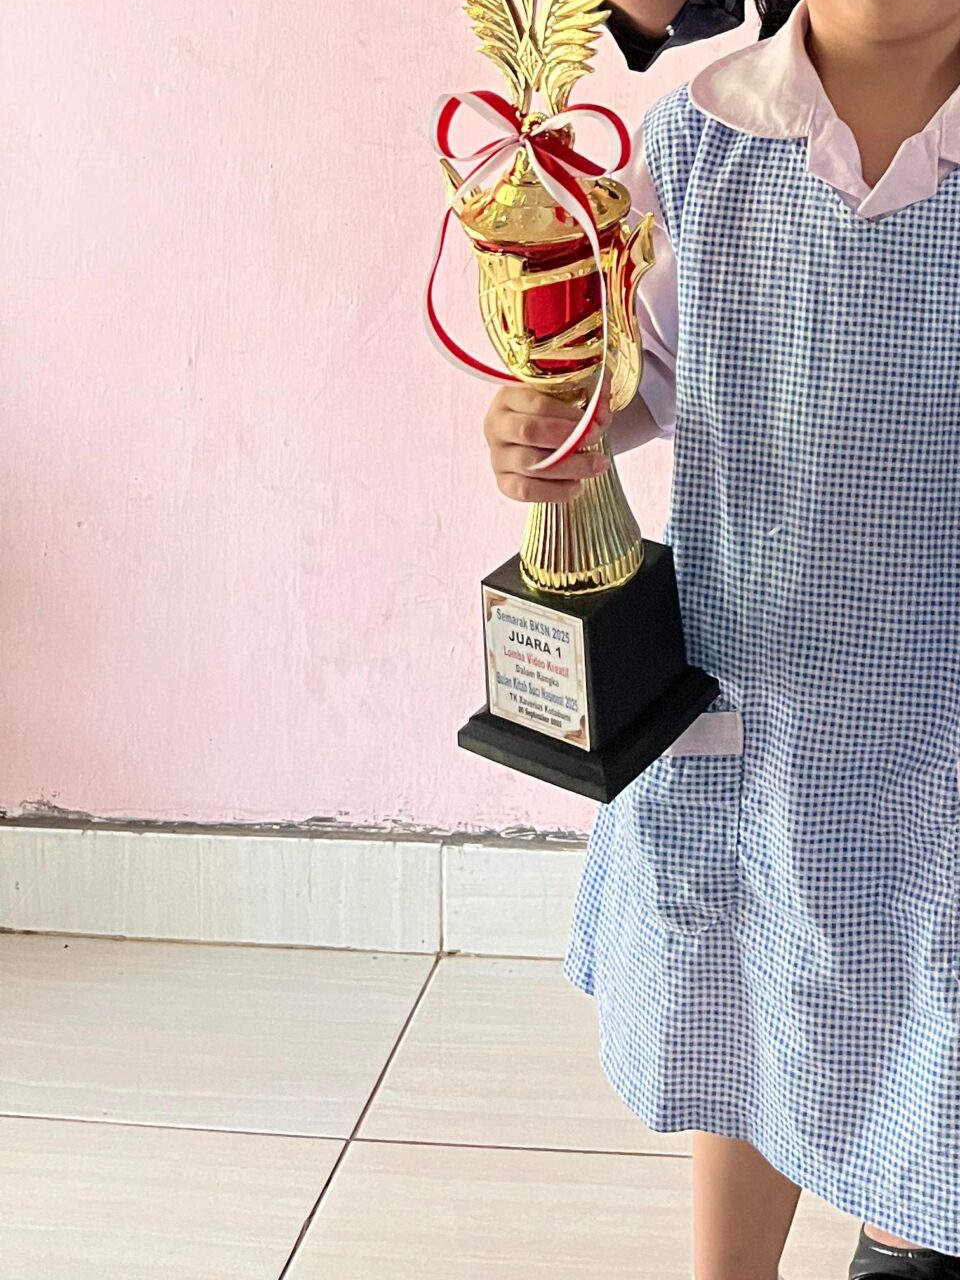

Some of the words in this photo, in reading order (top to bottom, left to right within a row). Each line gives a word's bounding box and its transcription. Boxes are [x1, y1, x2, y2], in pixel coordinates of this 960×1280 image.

[497, 608, 528, 629] Semarak
[530, 619, 551, 637] BKSN
[552, 627, 570, 644] 2025
[509, 631, 552, 655] JUARA
[556, 646, 562, 659] 1
[503, 645, 525, 663] Lomba
[527, 653, 546, 669] Video
[547, 661, 570, 679] Kreatif
[515, 664, 535, 679] Dalam
[537, 671, 559, 688] Rangka
[509, 692, 518, 703] TK
